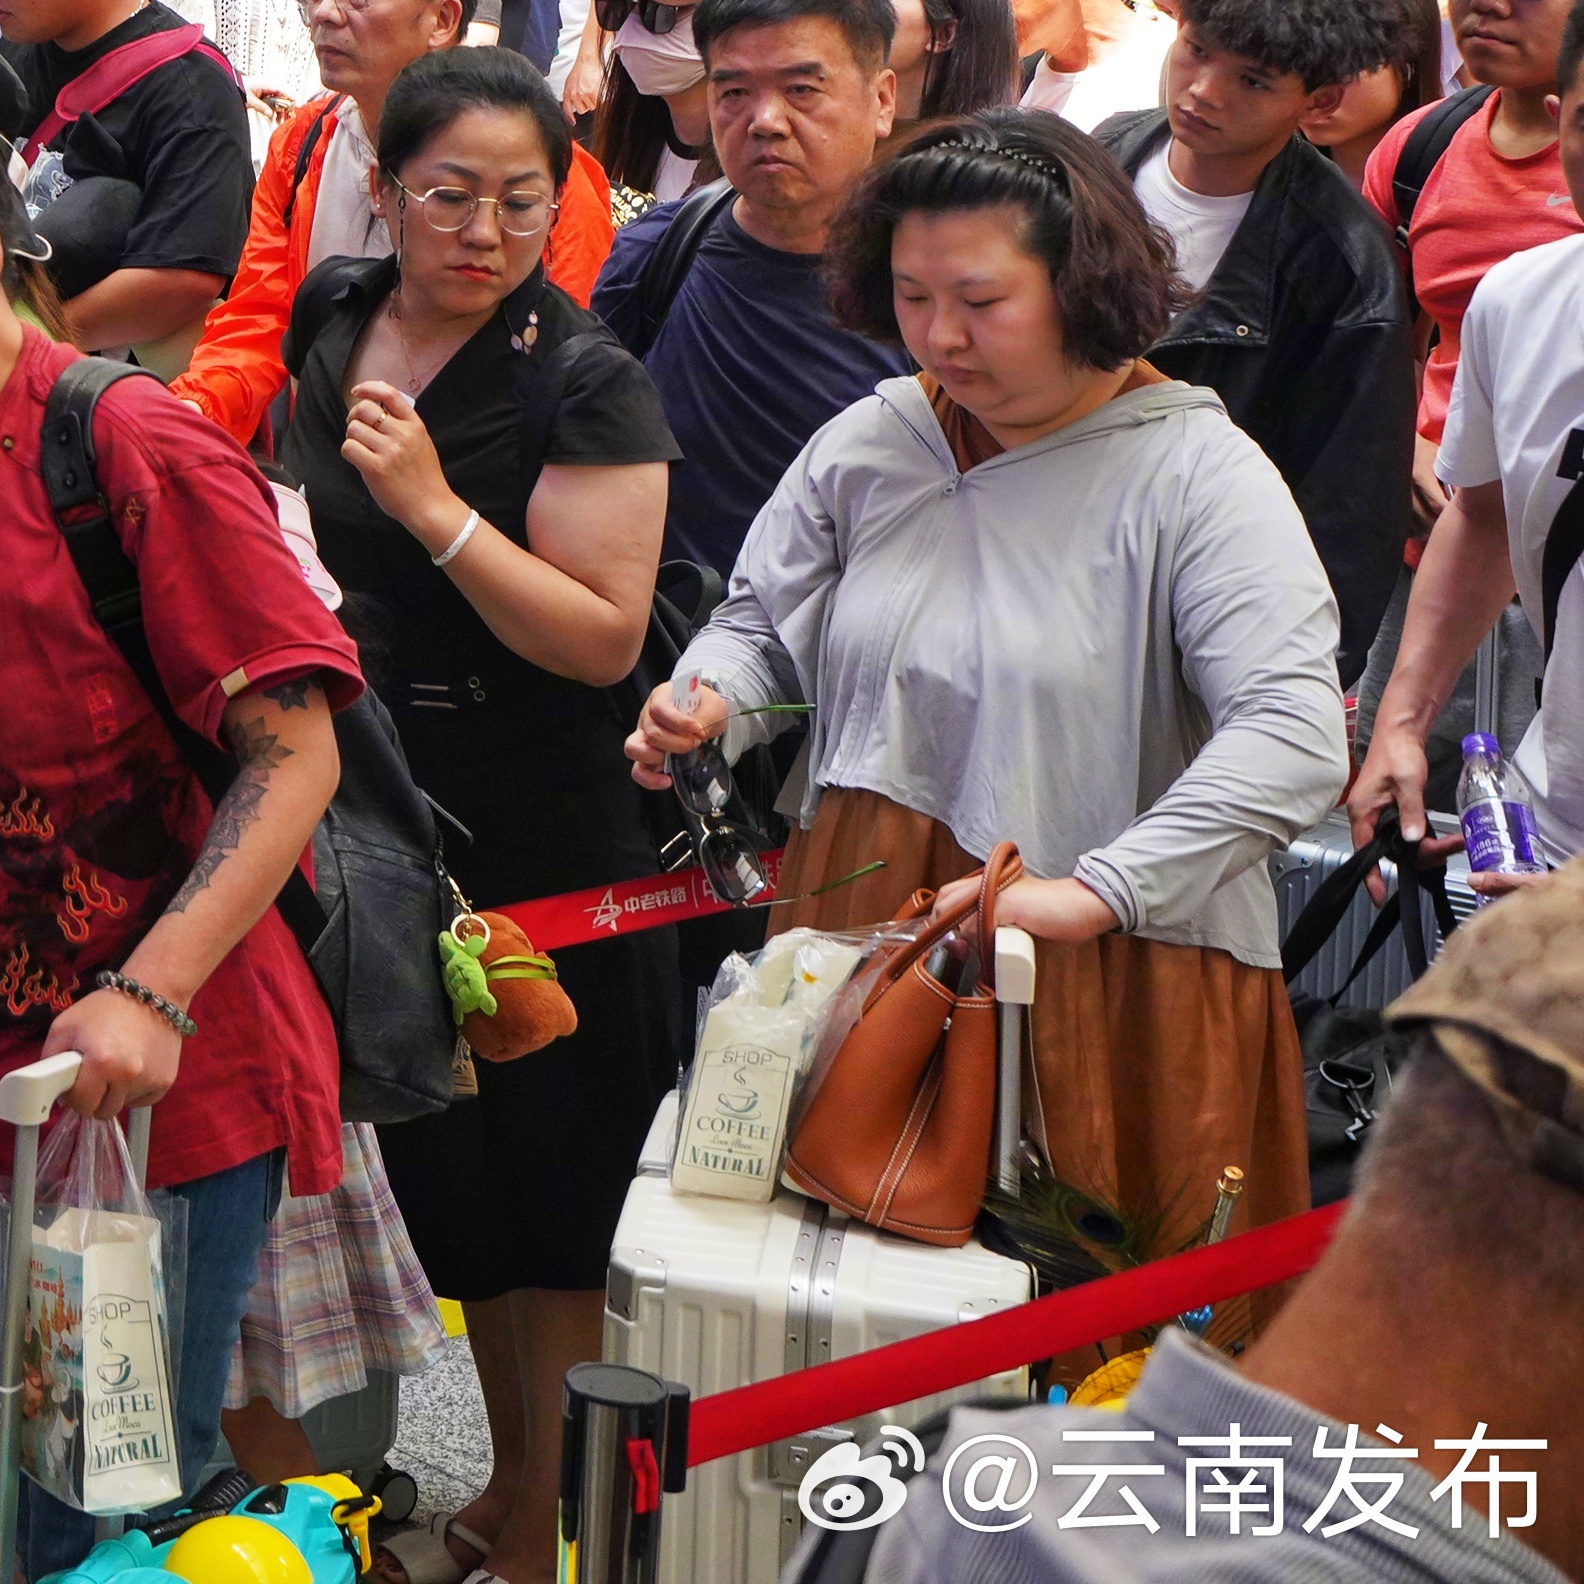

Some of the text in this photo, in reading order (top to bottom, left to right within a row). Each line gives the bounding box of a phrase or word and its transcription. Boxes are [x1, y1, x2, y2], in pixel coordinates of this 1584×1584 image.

[623, 886, 688, 914] 中老铁路
[722, 1049, 773, 1066] SHOP
[696, 1115, 771, 1141] COFFEE
[689, 1144, 764, 1178] NATURAL
[89, 1301, 132, 1325] SHOP
[91, 1392, 157, 1422] COFFEE
[93, 1432, 163, 1470] NATURAL
